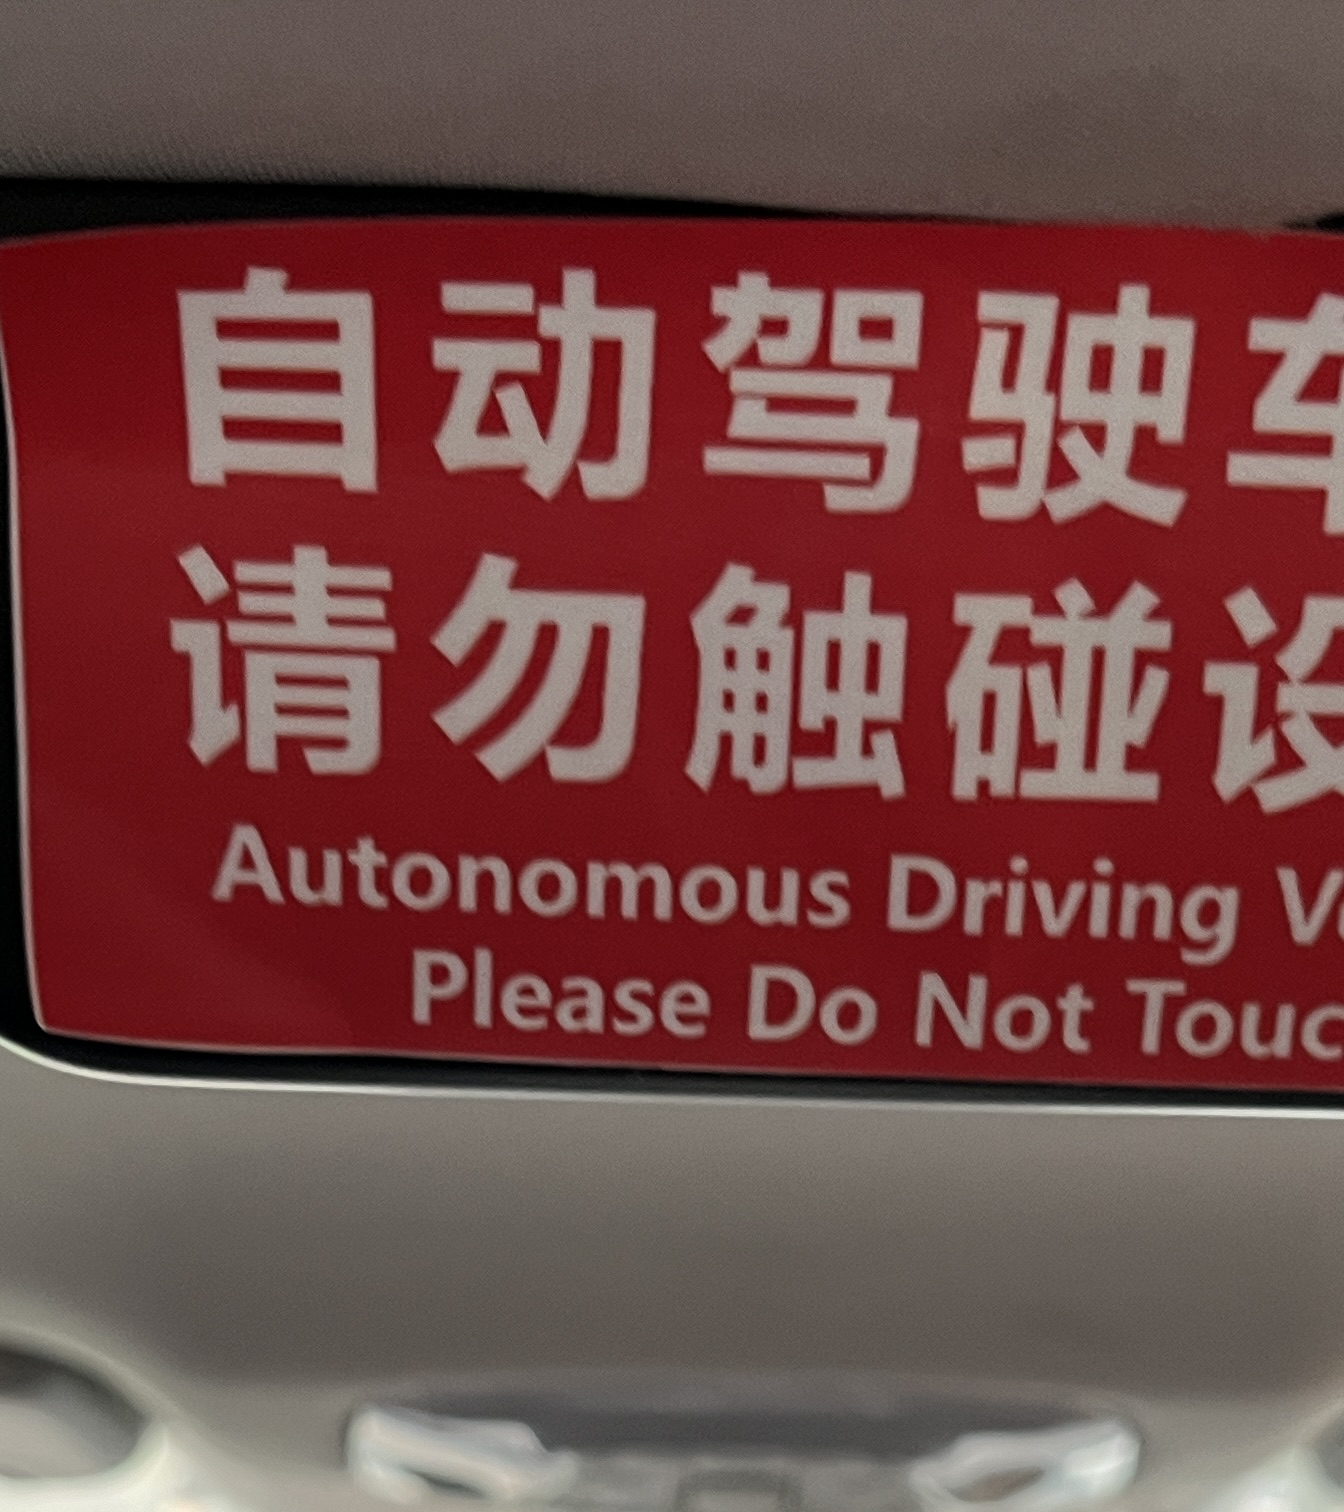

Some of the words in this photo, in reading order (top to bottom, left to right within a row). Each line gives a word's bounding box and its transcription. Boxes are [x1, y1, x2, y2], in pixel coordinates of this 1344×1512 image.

[214, 825, 850, 931] Autonomous
[887, 855, 1239, 965] Driving
[412, 948, 710, 1037] Please
[747, 965, 878, 1045] Do
[915, 972, 1094, 1052] Not
